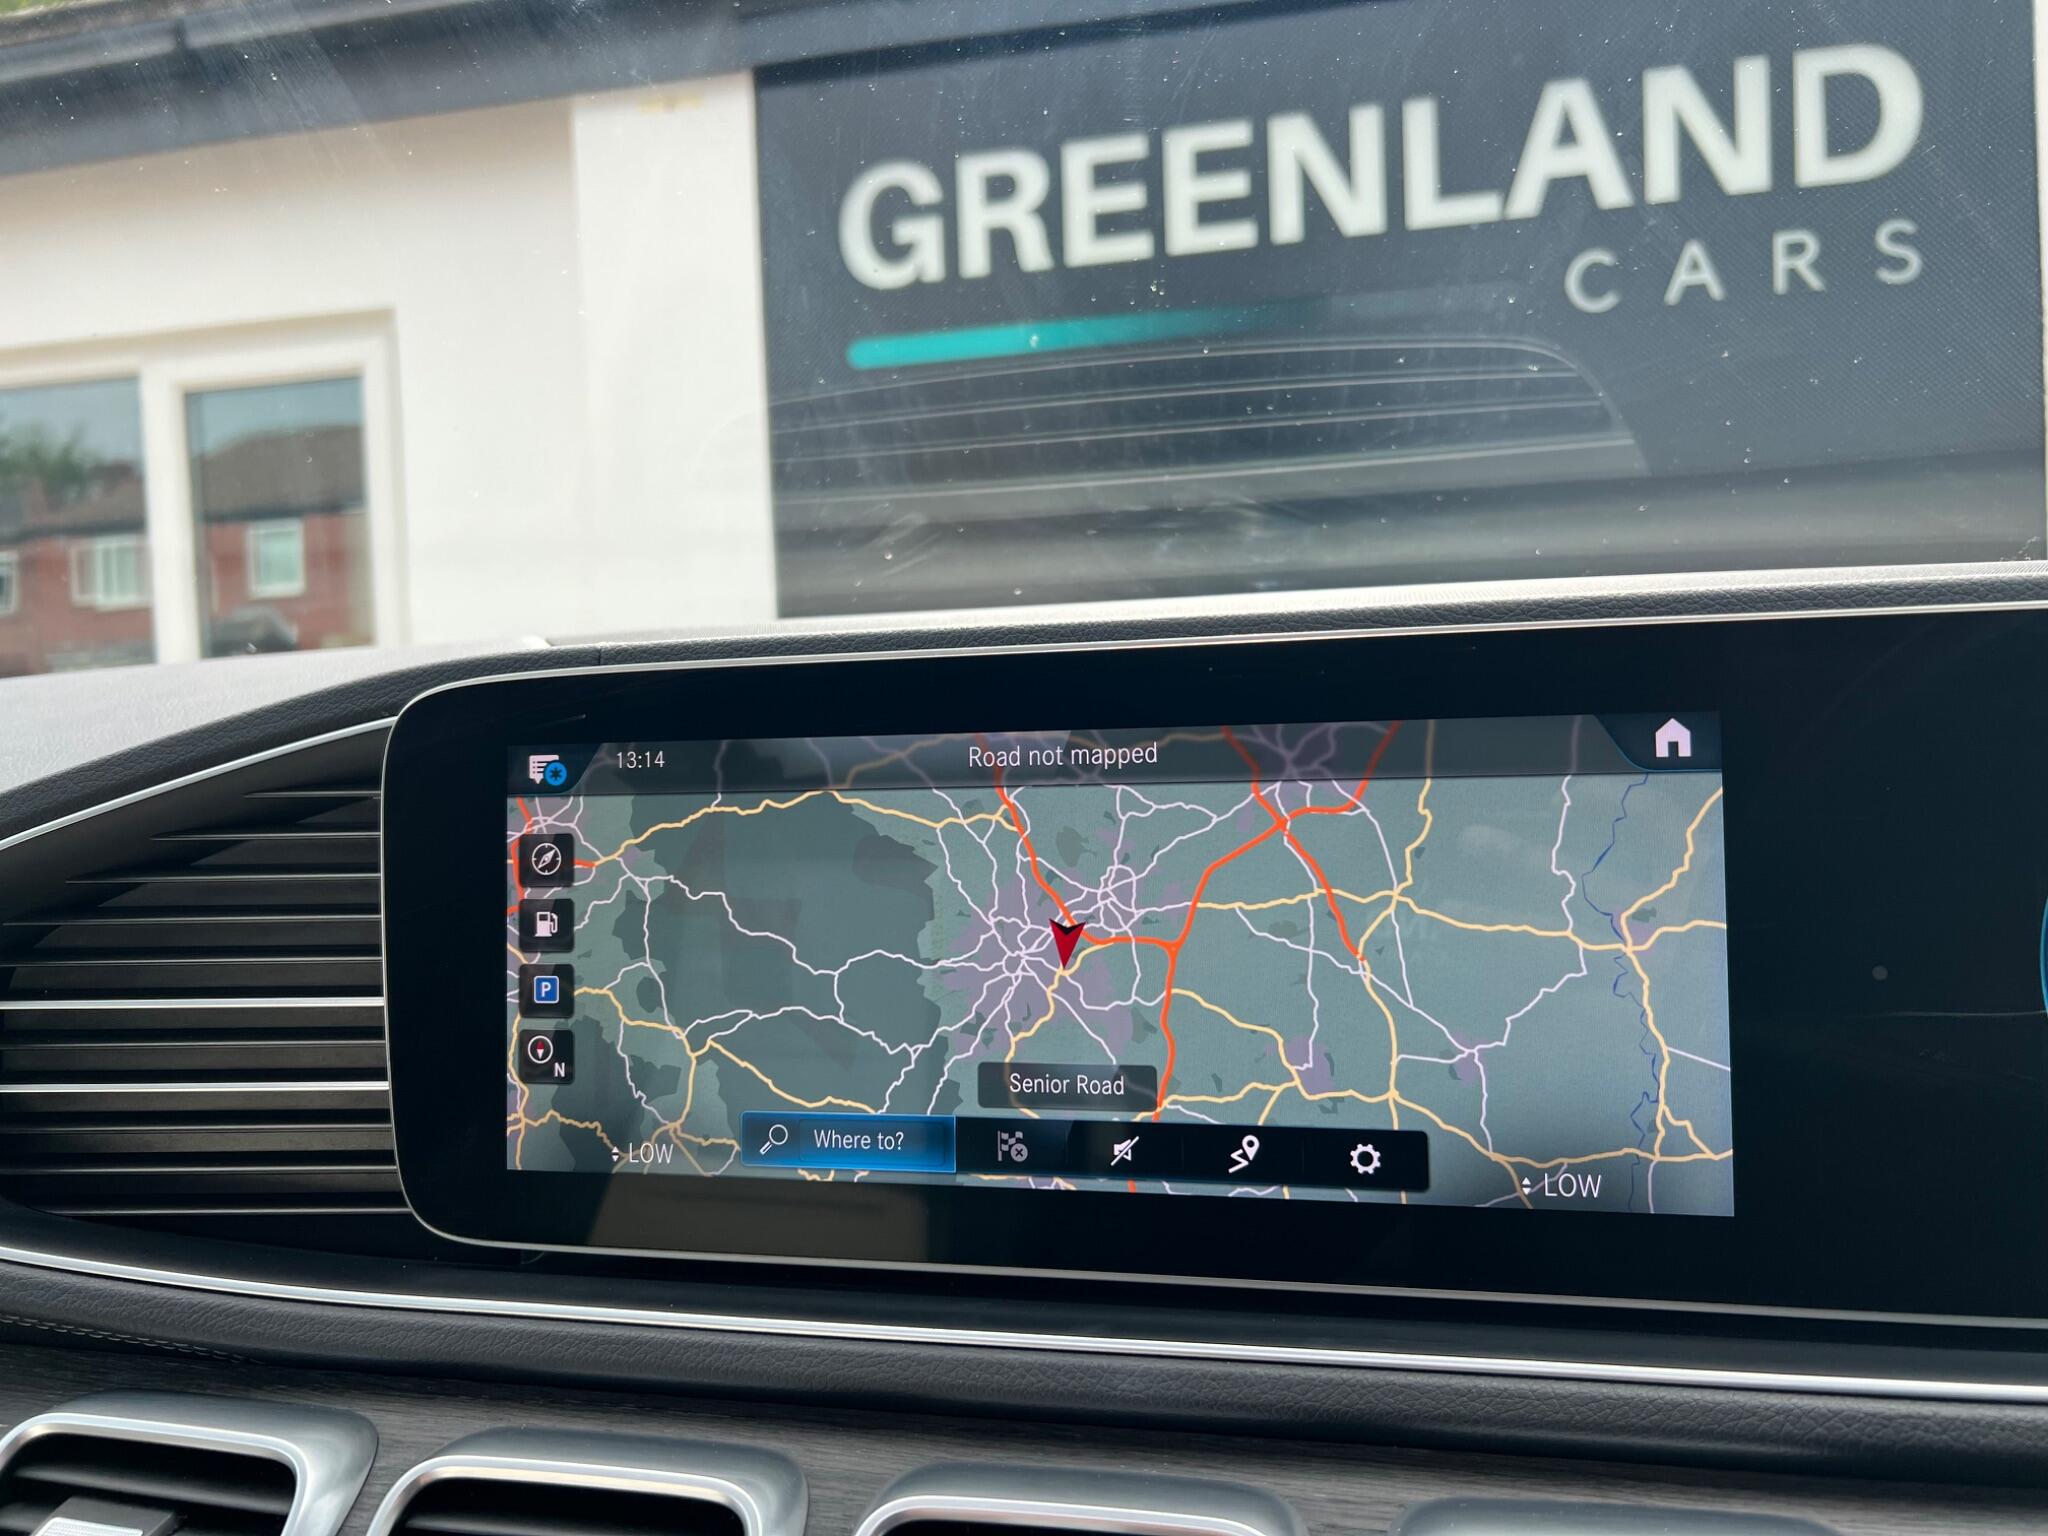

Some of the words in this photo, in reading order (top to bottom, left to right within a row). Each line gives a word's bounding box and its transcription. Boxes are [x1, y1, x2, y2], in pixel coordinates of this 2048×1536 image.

[838, 43, 1926, 291] GREENLAND
[1563, 219, 1925, 314] CARS
[616, 751, 665, 768] 13:14
[968, 745, 1021, 768] Road
[1028, 746, 1064, 767] not
[1070, 742, 1158, 770] mapped
[541, 982, 552, 997] P
[554, 1062, 565, 1077] N
[1009, 1073, 1071, 1095] Senior
[1076, 1074, 1125, 1096] Road
[813, 1128, 871, 1150] Where
[876, 1130, 905, 1151] to?
[629, 1142, 674, 1165] LOW
[1545, 1173, 1601, 1198] LOW
